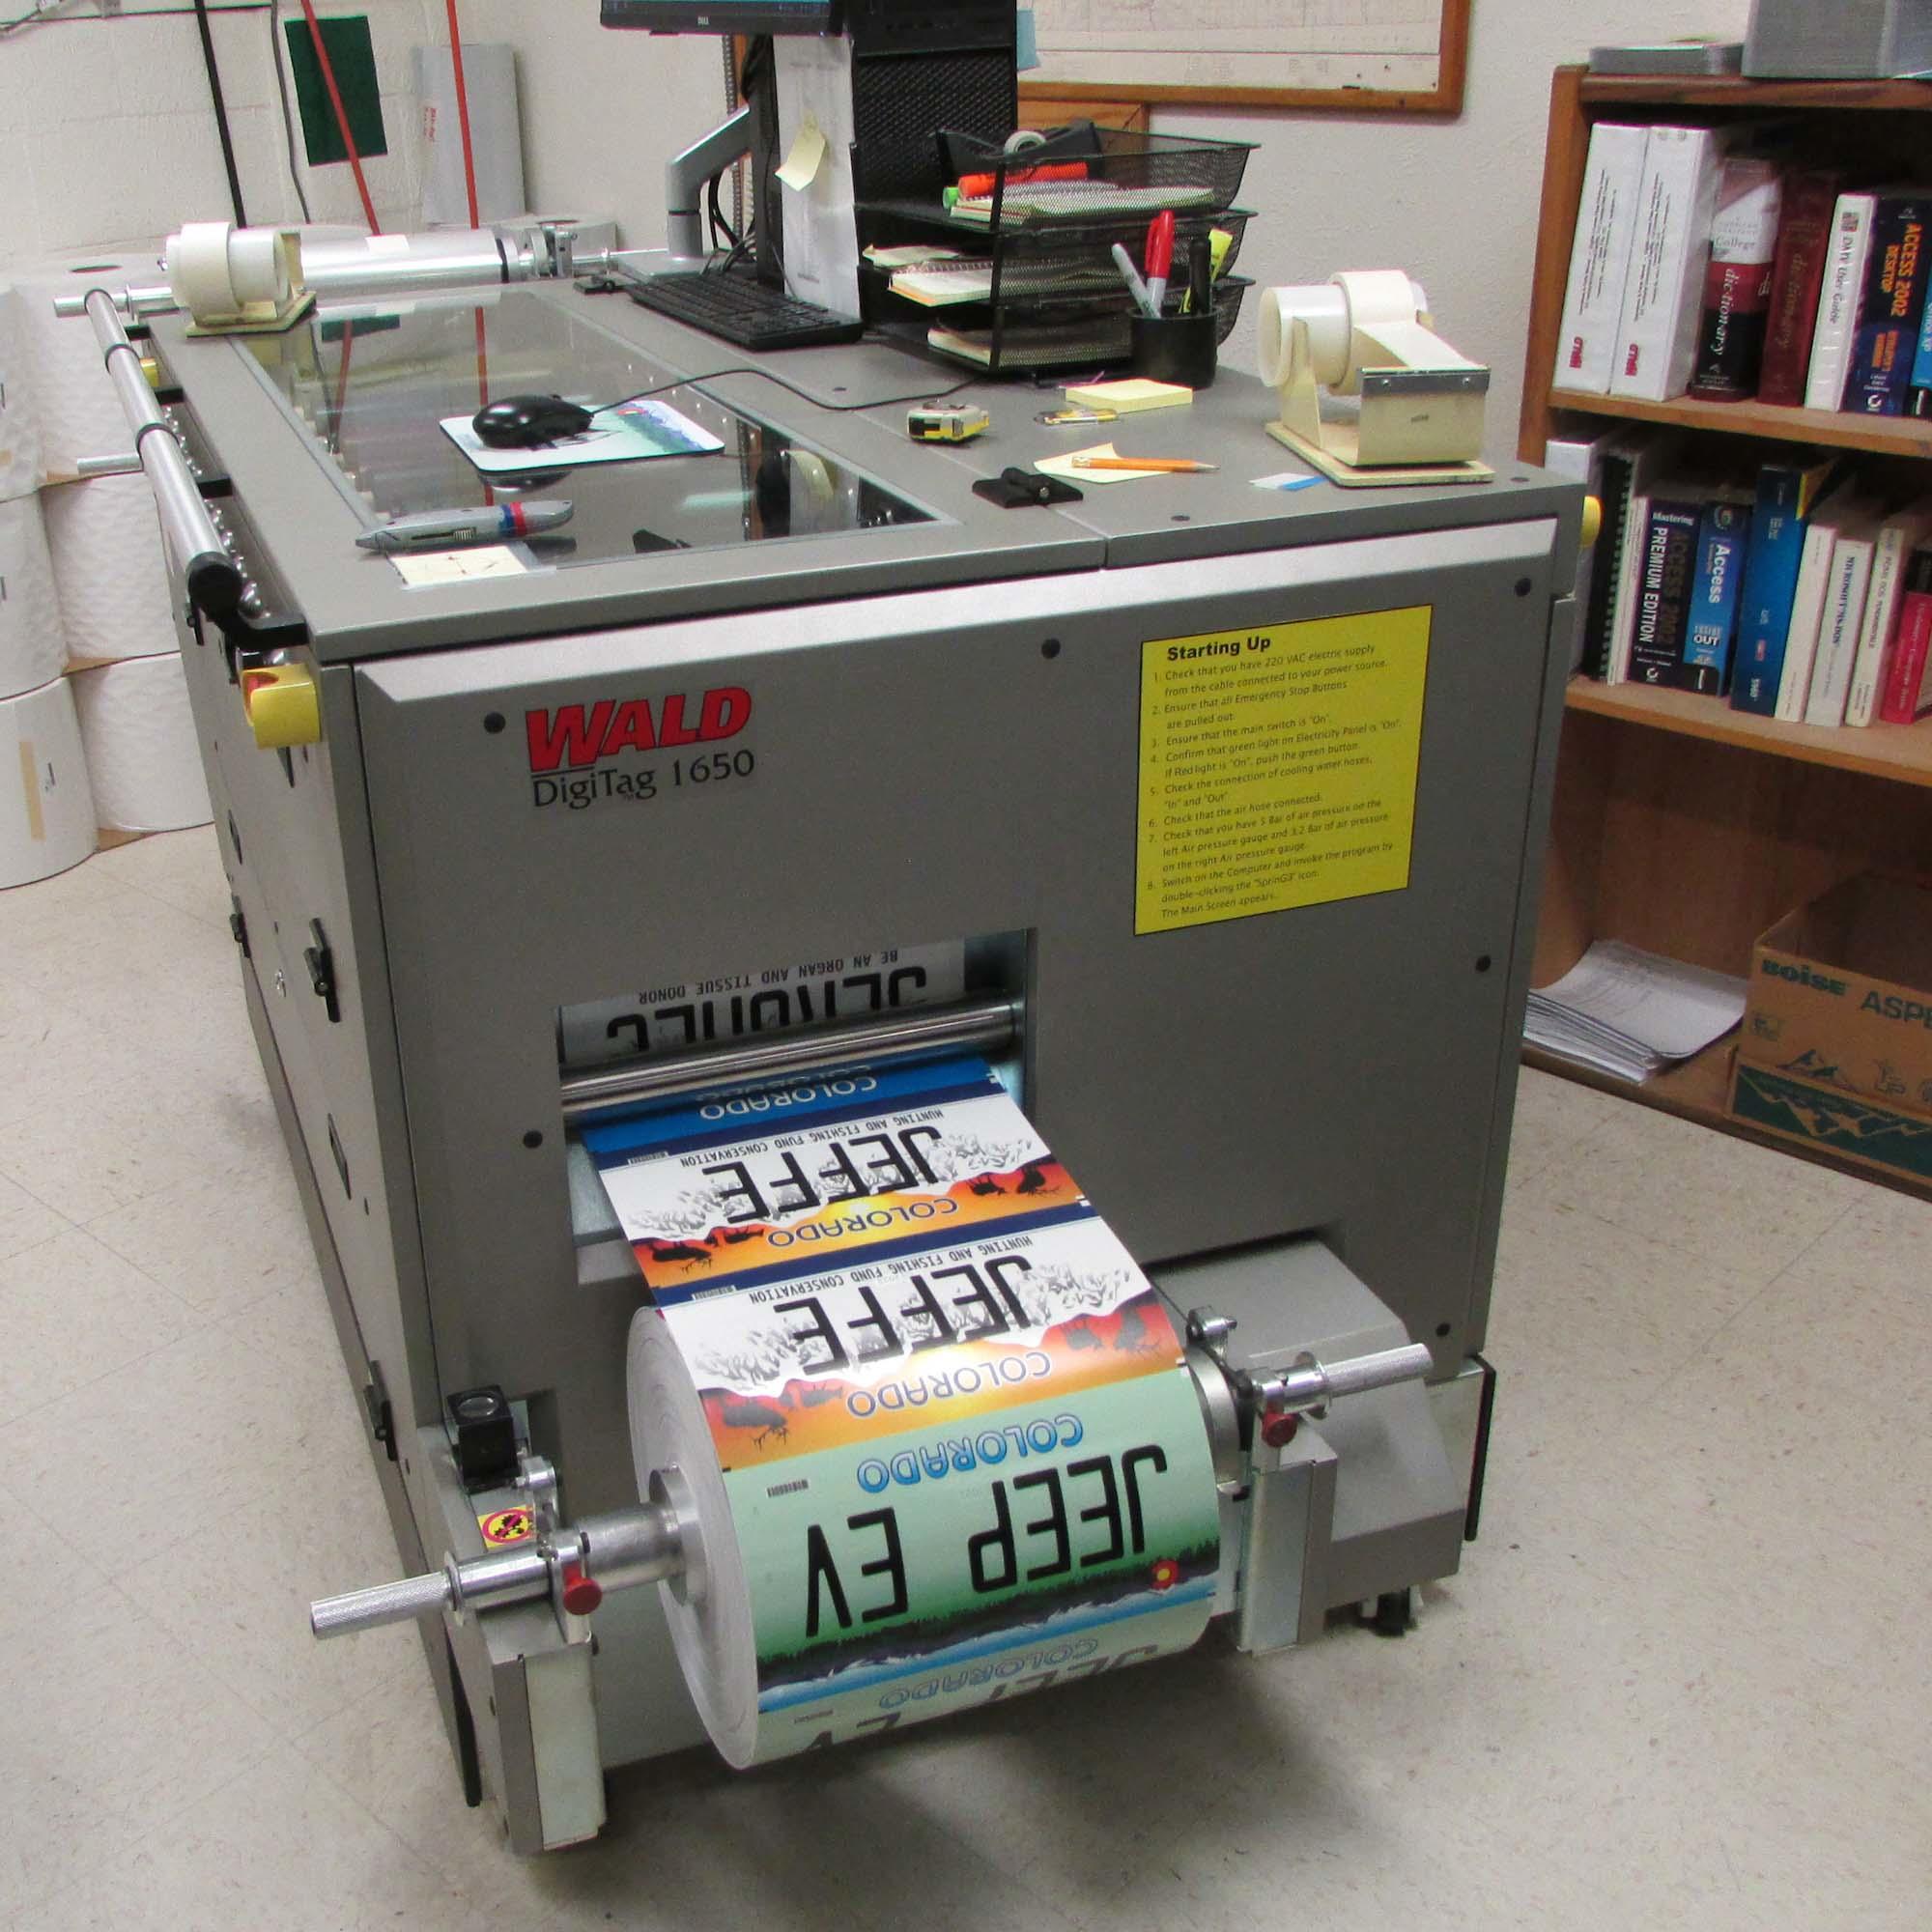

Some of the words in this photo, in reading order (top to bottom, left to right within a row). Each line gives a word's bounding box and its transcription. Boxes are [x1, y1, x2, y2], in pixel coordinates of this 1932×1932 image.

[1899, 223, 1922, 277] ACCESS
[1891, 279, 1912, 317] 2002
[1653, 512, 1694, 526] Mastering
[1646, 526, 1668, 589] PREMIUM
[1708, 544, 1732, 604] Access
[1639, 594, 1660, 644] EDITION
[1167, 641, 1240, 661] Starting
[1247, 637, 1271, 652] Up
[1693, 636, 1719, 646] OUT
[526, 686, 752, 772] WALD
[532, 769, 657, 810] DigiTag
[672, 750, 754, 786] 1650
[803, 957, 844, 977] ORGAN
[853, 952, 874, 967] AN
[881, 949, 898, 964] BE
[696, 974, 751, 997] TISSUE
[761, 968, 789, 984] AND
[639, 985, 687, 1006] DONOR
[698, 1075, 879, 1122] COLORADO
[865, 1119, 888, 1131] AND
[893, 1109, 944, 1127] HUNTING
[775, 1133, 806, 1149] FUND
[810, 1122, 861, 1144] FISHING
[680, 1140, 769, 1169] CONSERVATION
[701, 1125, 943, 1225] JEFFE
[766, 1197, 959, 1249] COLORADO
[947, 1247, 974, 1262] AND
[980, 1236, 1033, 1256] HUNTING
[850, 1264, 883, 1282] FUND
[888, 1253, 941, 1276] FISHING
[749, 1271, 845, 1304] CONSERVATION
[774, 1254, 1032, 1376] JEFFE
[846, 1350, 1053, 1418] COLORADO
[857, 1413, 1085, 1493] COLORADO
[967, 1444, 1168, 1594] JEEP
[805, 1506, 910, 1638] EV
[878, 1637, 1099, 1710] COLORADO
